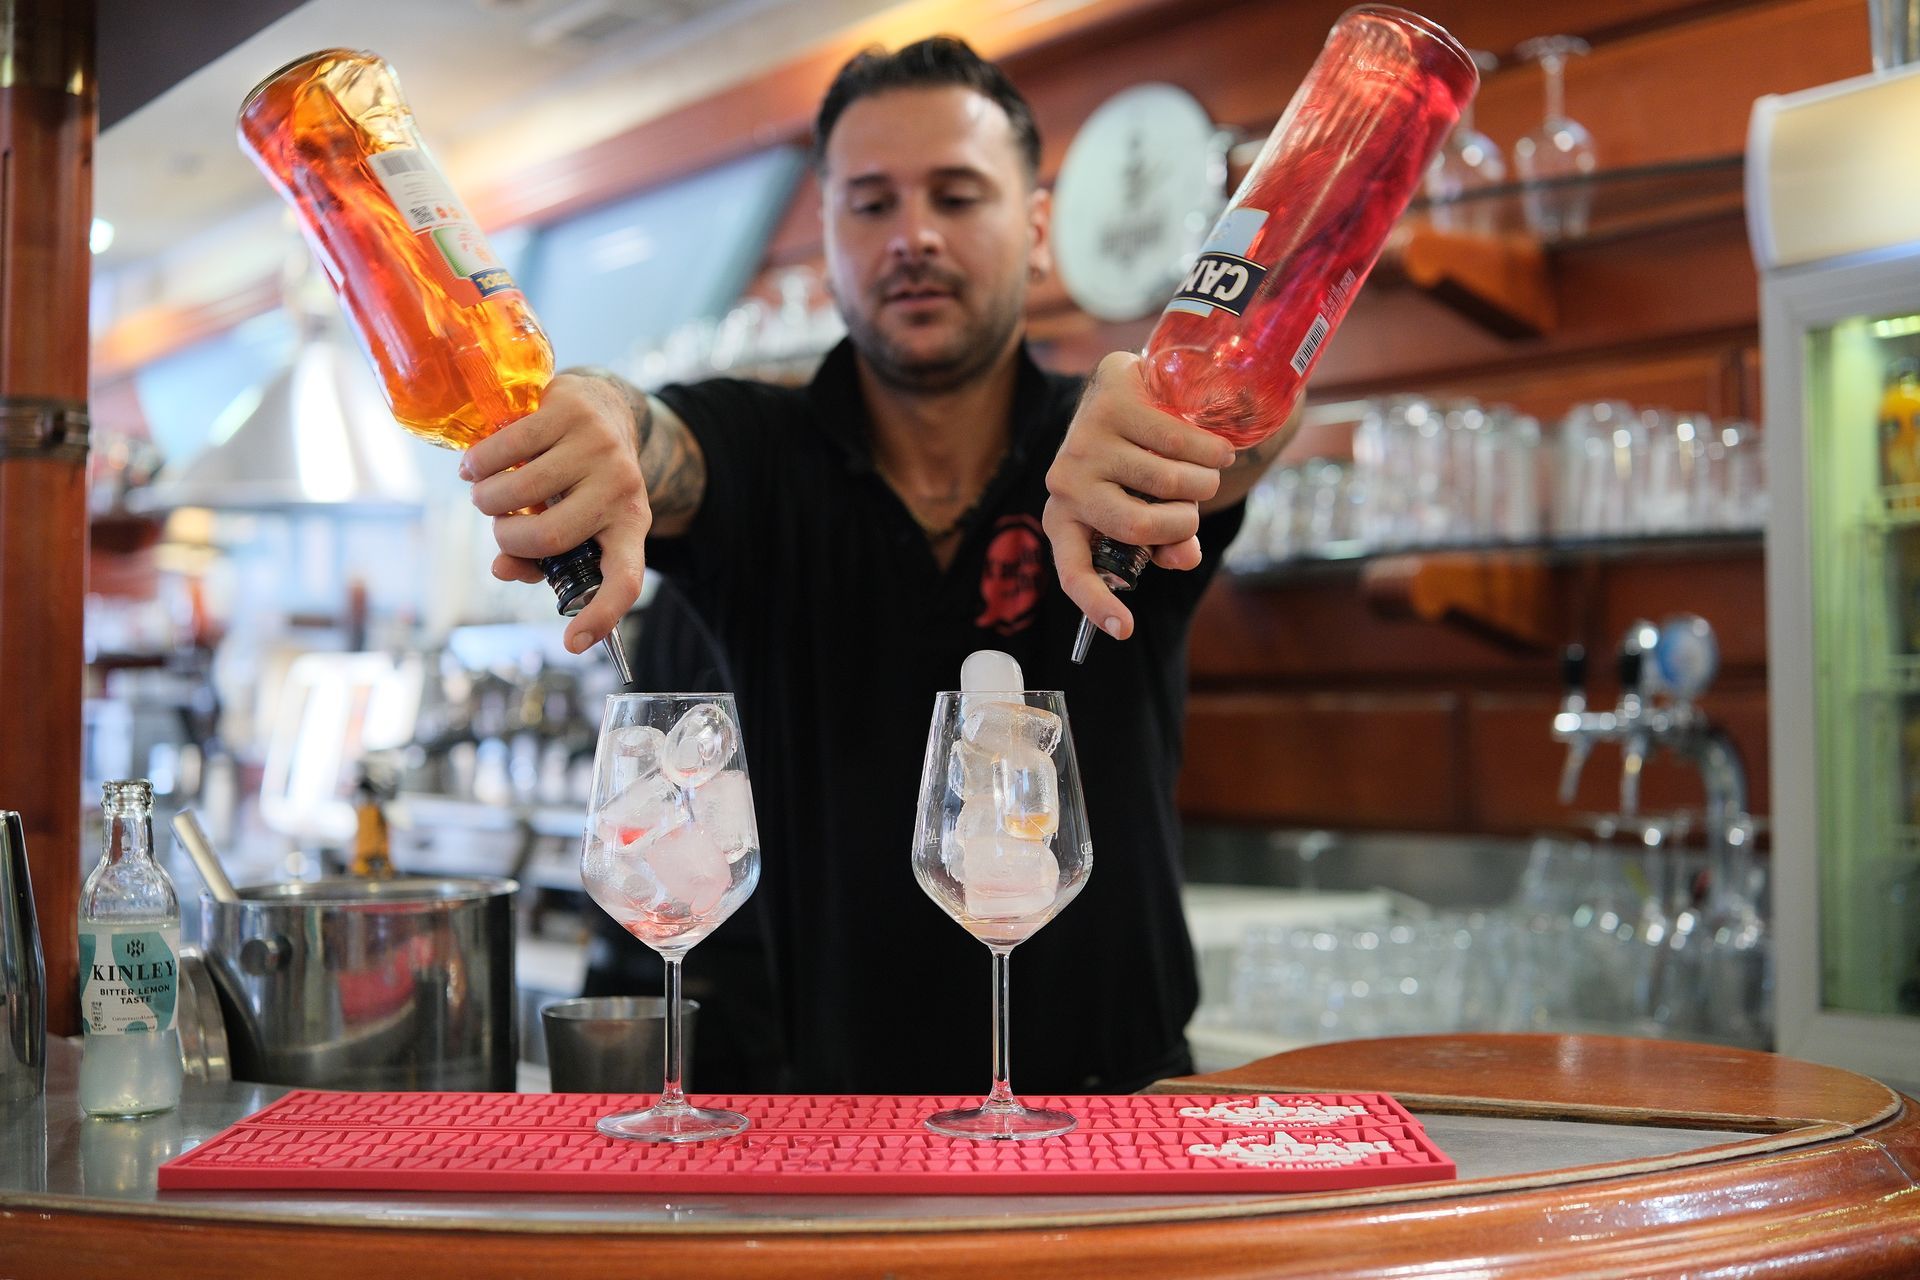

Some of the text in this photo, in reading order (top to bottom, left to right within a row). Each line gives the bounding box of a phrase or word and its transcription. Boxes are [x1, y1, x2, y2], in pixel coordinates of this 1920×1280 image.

[93, 960, 174, 981] KINLEY
[100, 984, 170, 996] BITTER LEMON
[120, 996, 152, 1005] TASTE
